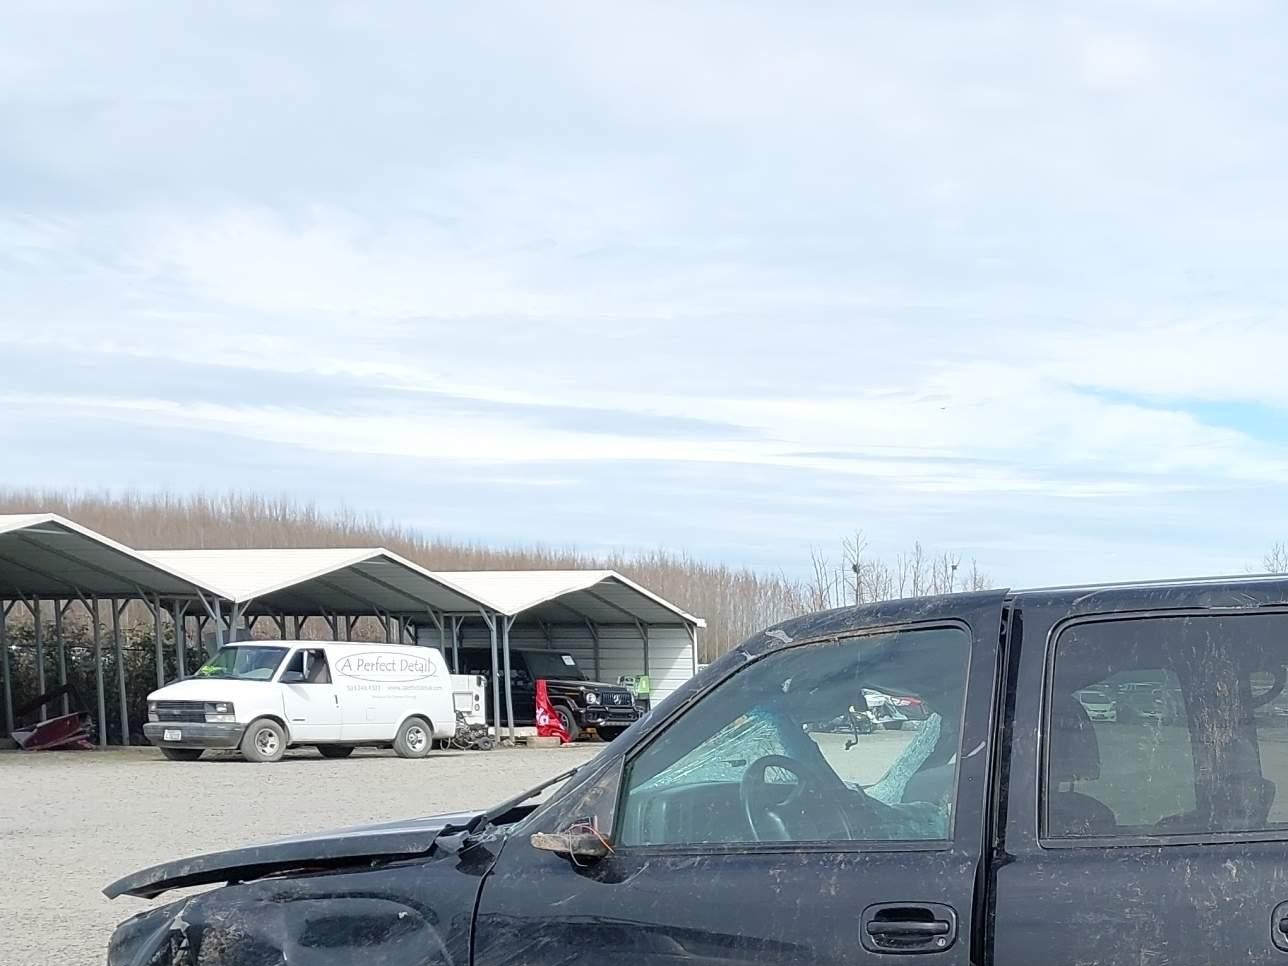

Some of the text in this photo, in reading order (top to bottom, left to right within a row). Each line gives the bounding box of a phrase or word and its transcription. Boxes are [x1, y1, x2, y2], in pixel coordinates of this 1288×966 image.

[340, 656, 431, 673] A Perfect Detail
